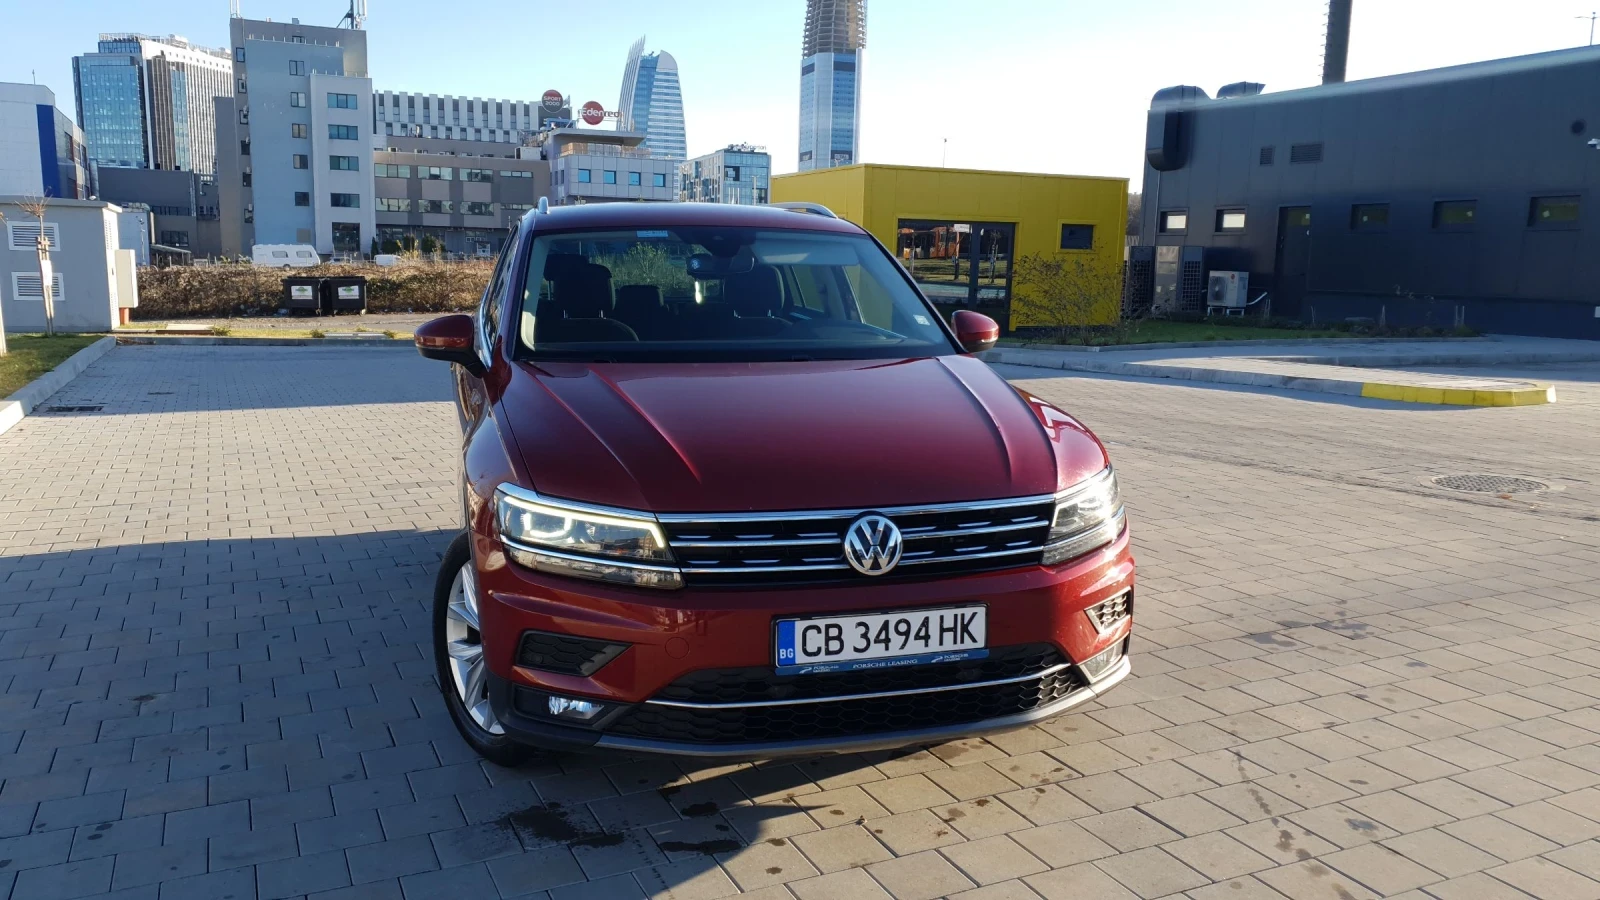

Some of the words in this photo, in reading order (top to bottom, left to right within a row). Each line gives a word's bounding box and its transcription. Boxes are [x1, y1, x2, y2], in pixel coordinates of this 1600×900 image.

[801, 623, 845, 657] CB
[852, 616, 931, 654] 3494
[938, 611, 978, 646] HK
[779, 648, 794, 659] BG
